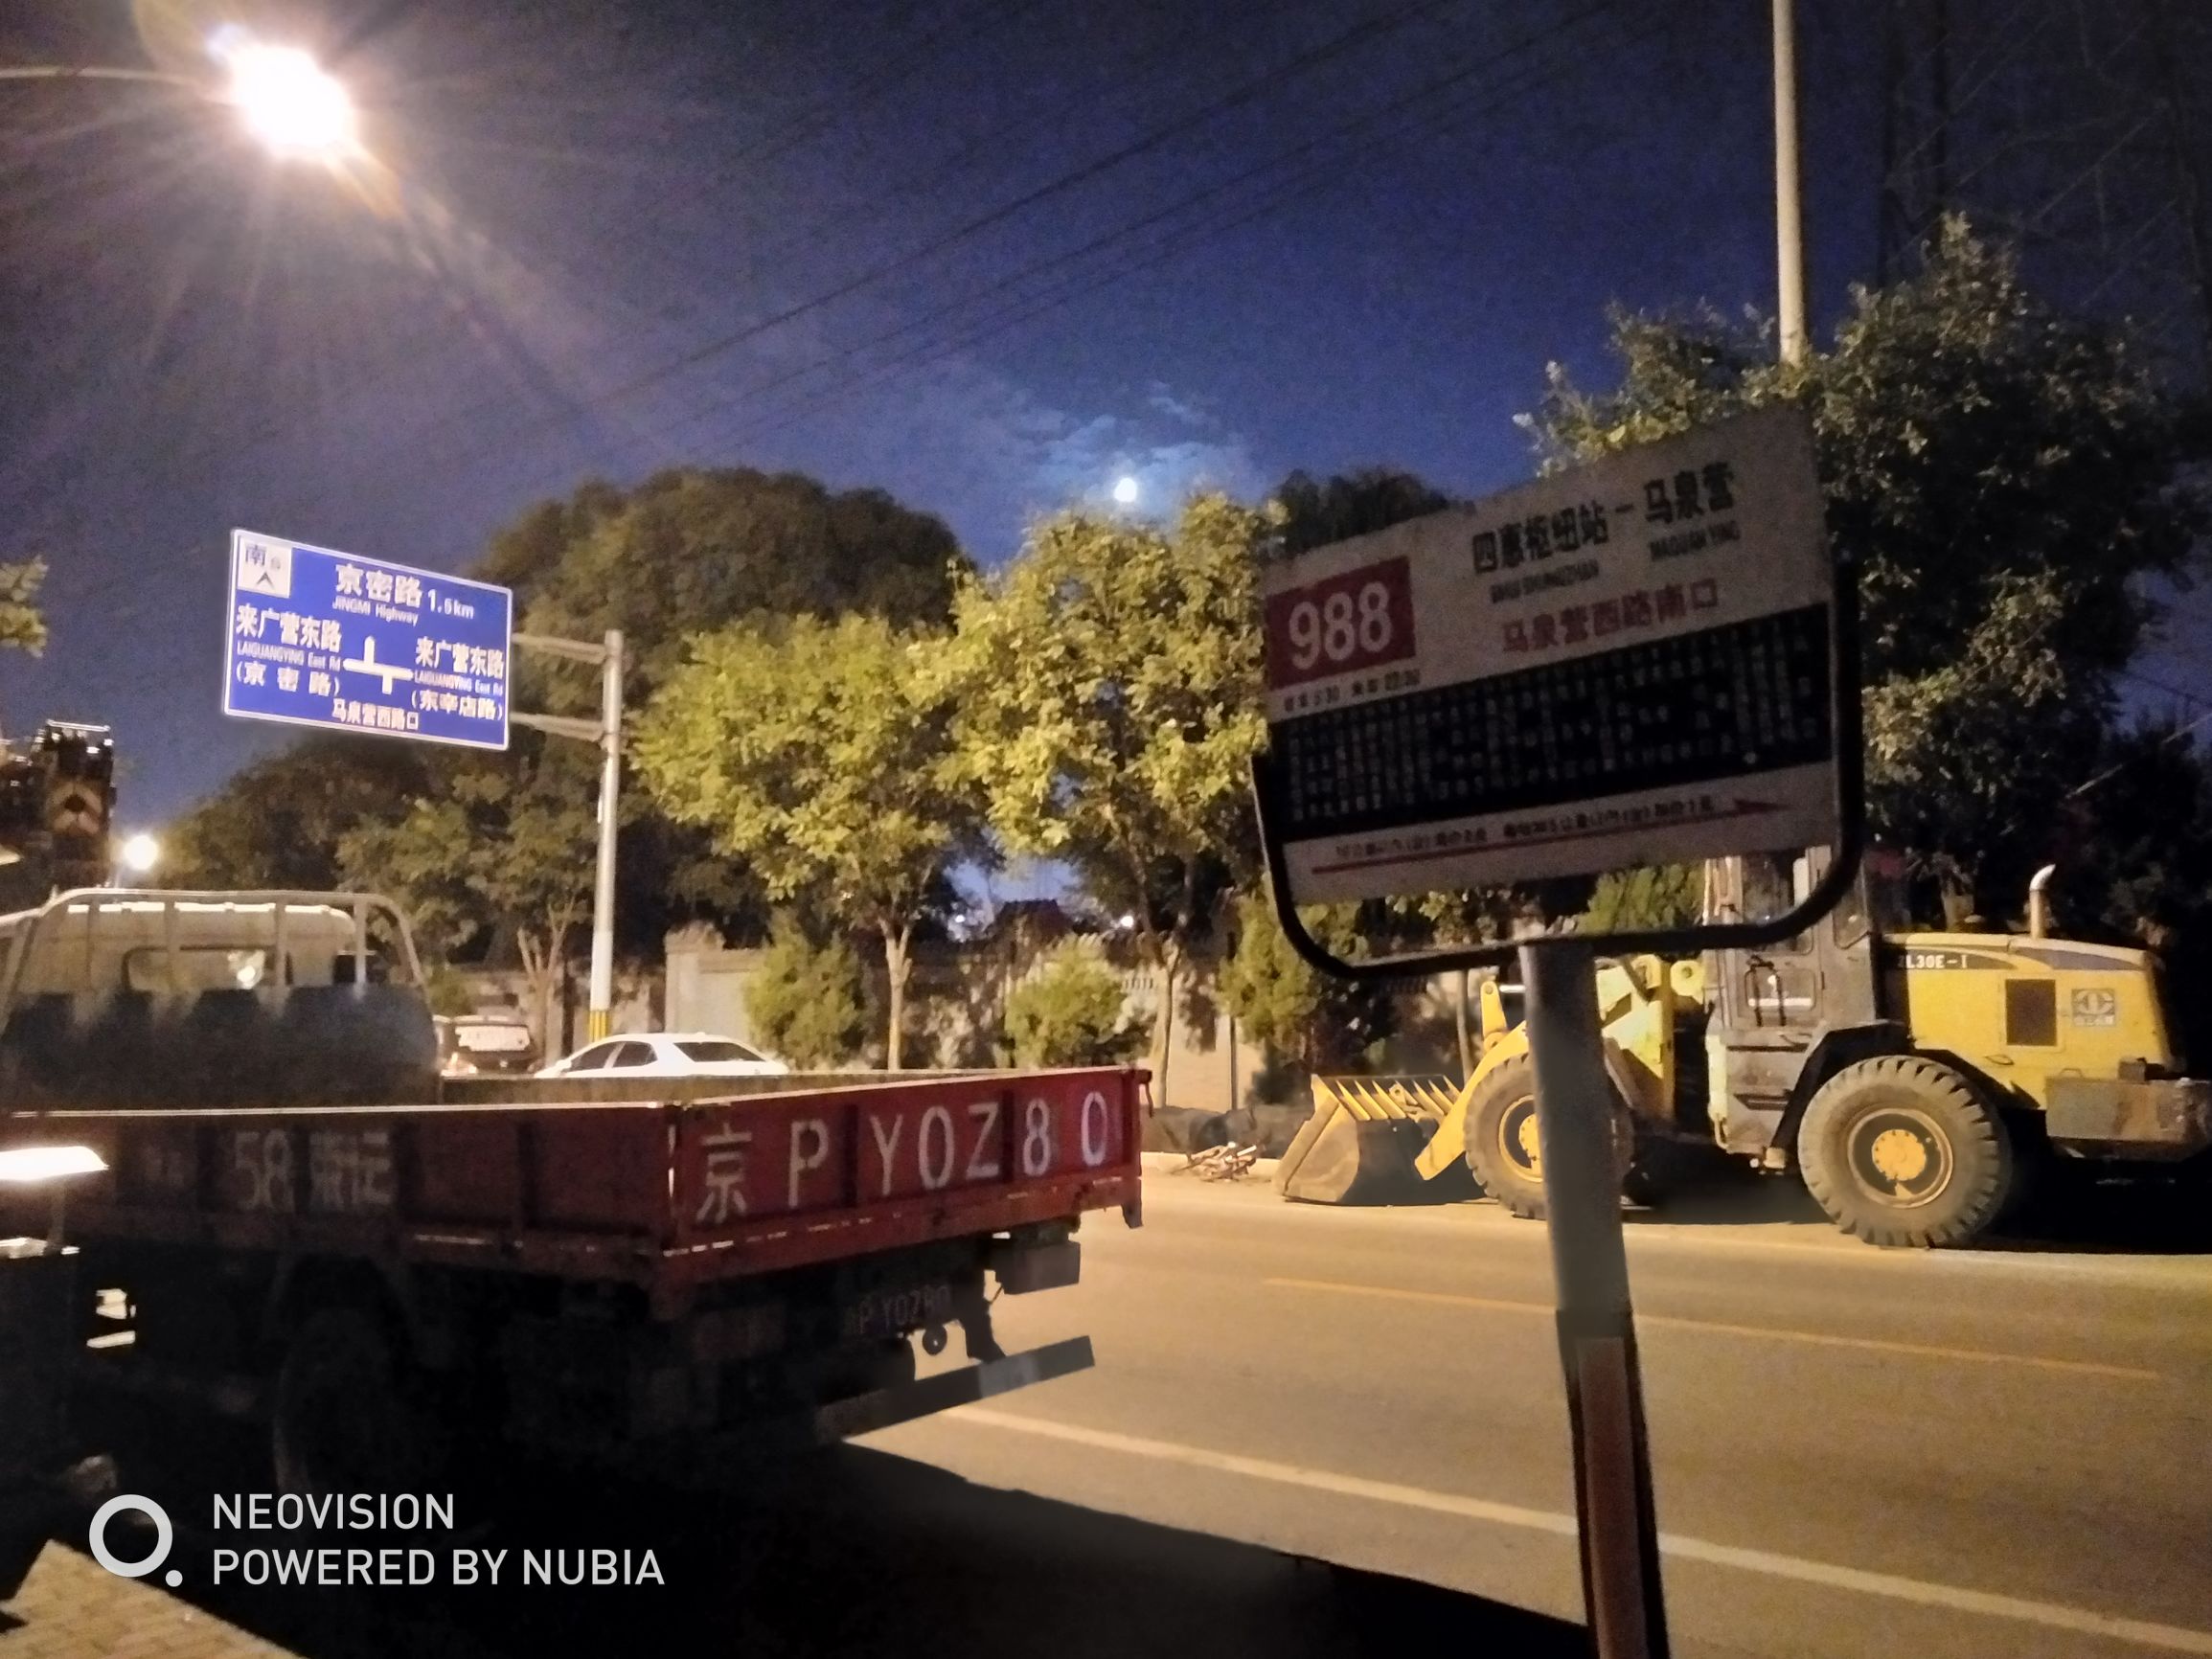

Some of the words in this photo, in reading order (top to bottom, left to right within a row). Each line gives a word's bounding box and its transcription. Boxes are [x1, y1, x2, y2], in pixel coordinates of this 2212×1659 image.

[245, 544, 266, 566] 南
[335, 563, 422, 608] 京密路
[236, 602, 342, 653] 来广营东路
[332, 595, 371, 616] JINGMI
[376, 602, 419, 627] Highway
[1288, 581, 1393, 670] 988
[415, 635, 505, 680] 来广营东路
